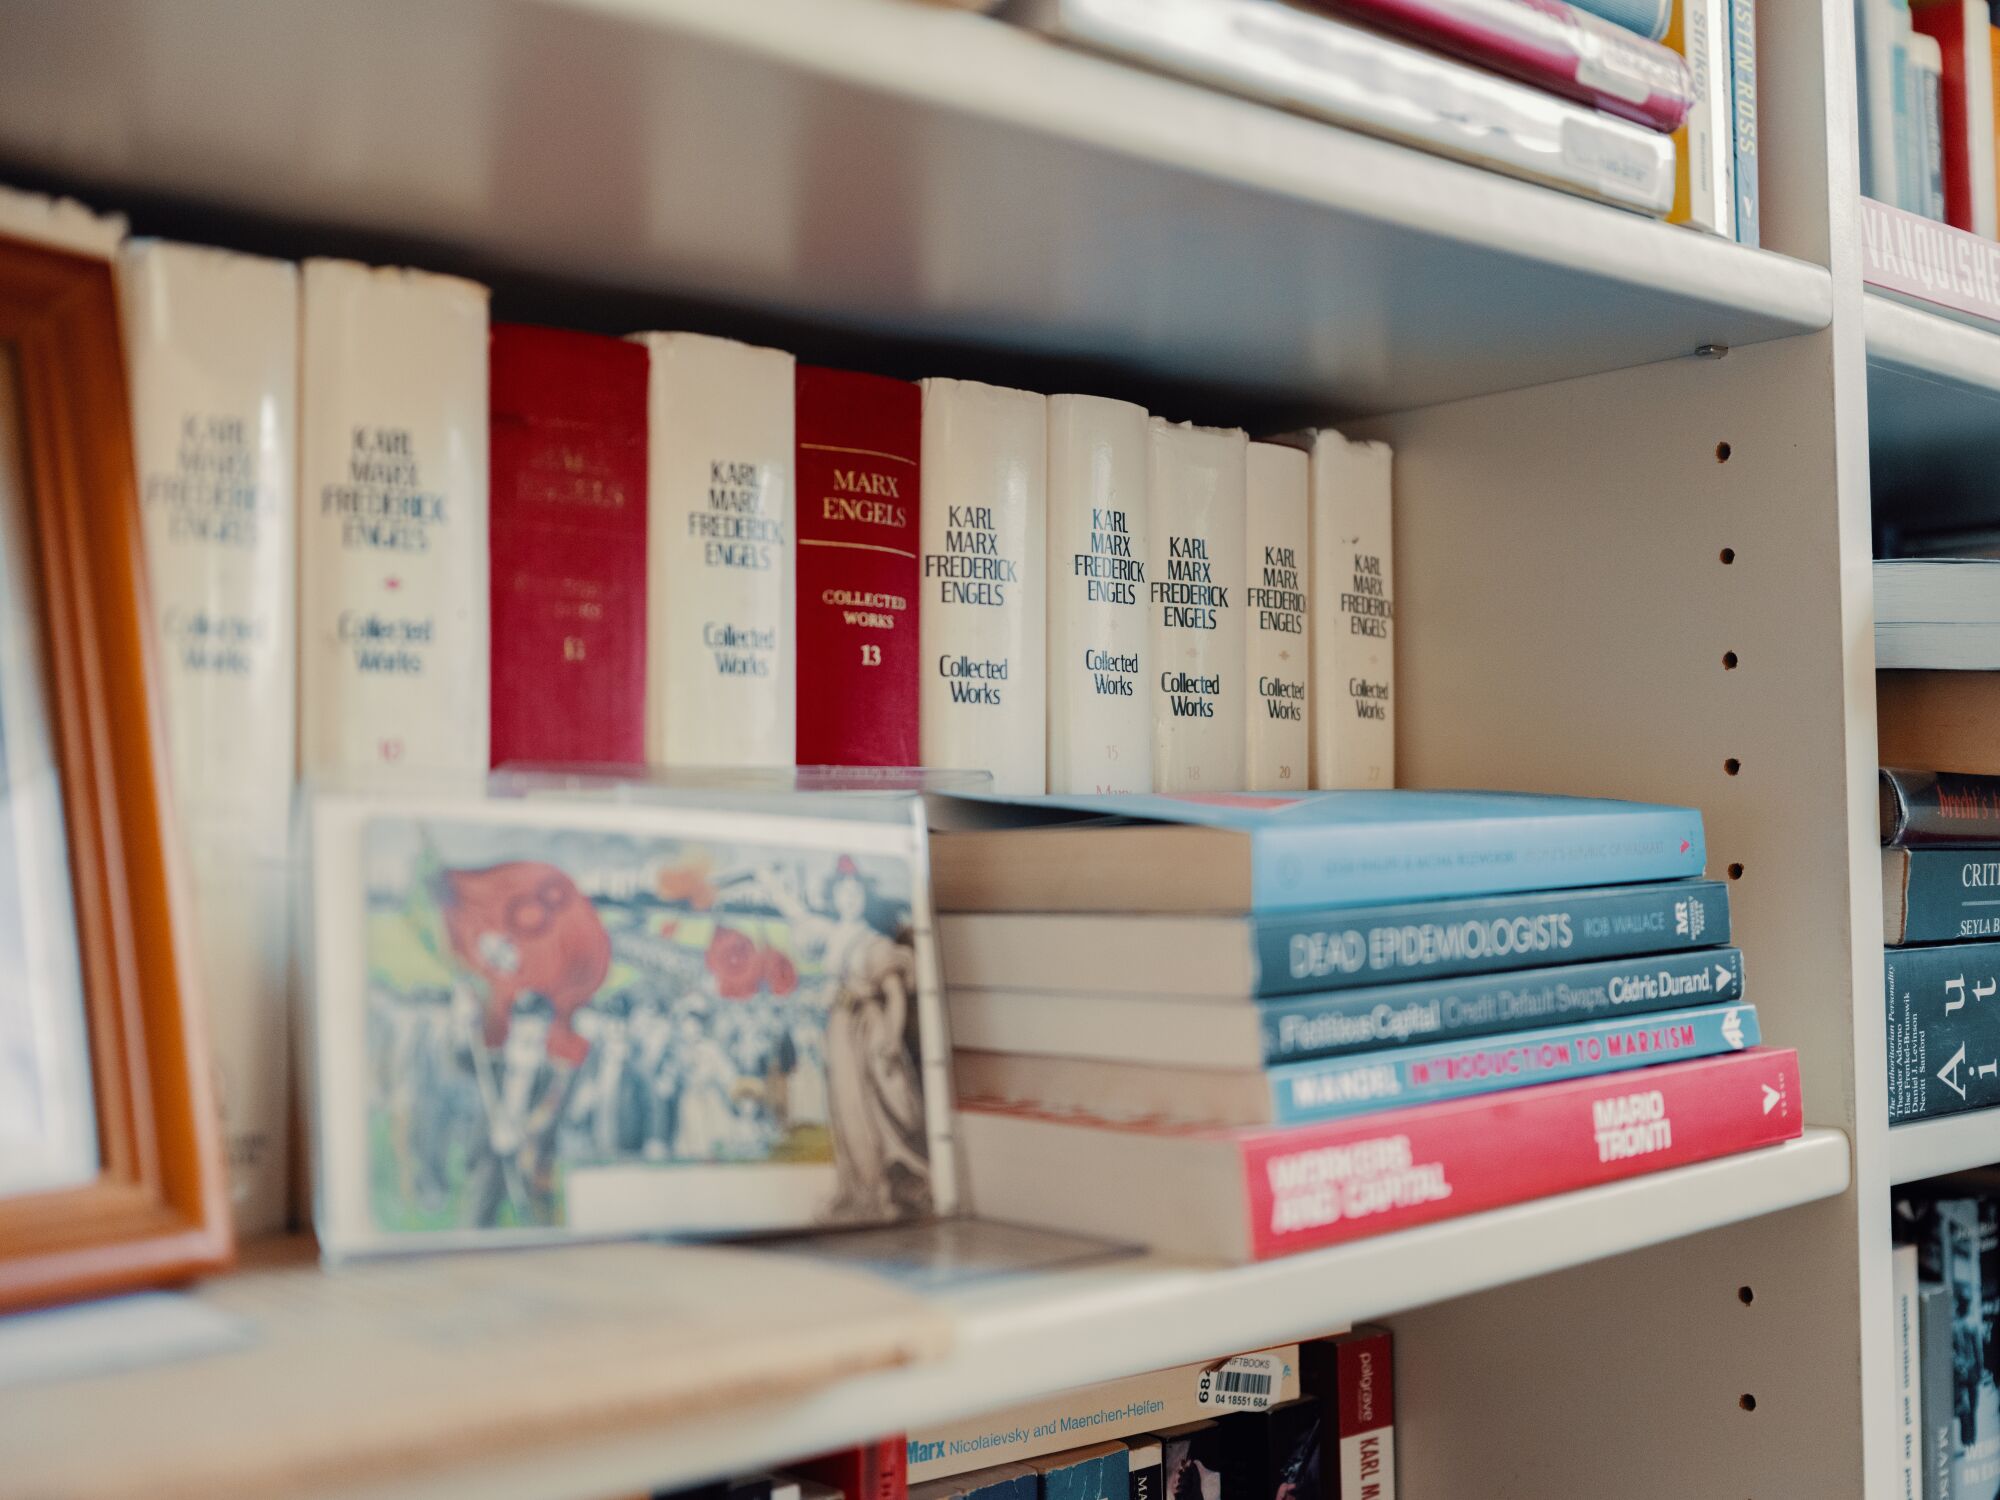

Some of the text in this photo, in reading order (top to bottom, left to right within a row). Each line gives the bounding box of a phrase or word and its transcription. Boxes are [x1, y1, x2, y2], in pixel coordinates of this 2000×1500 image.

[1738, 78, 1755, 155] ROSS
[834, 469, 899, 498] MARX
[823, 498, 906, 528] ENGELS
[949, 505, 995, 531] KARL
[1093, 508, 1128, 533] KARL
[946, 531, 998, 556] MARX
[1091, 532, 1131, 557] MARX
[1169, 536, 1208, 560] KARL
[925, 555, 1017, 583] FREDERICK
[1074, 555, 1145, 583] FREDERICK
[1265, 546, 1296, 569] KARL
[1354, 554, 1381, 577] KARL
[1167, 560, 1211, 583] MARX
[1263, 568, 1298, 590] MARX
[941, 582, 1004, 606] ENGELS
[1088, 580, 1136, 605] ENGELS
[1151, 582, 1229, 608] FREDERICK
[1353, 575, 1383, 597] MARX
[822, 590, 906, 610] COLLECTED
[844, 612, 894, 629] WORKS
[1163, 606, 1217, 630] ENGELS
[1259, 611, 1302, 634] ENGELS
[1351, 616, 1387, 639] ENGELS
[861, 645, 881, 666] 13
[939, 655, 1008, 680] Collected
[1085, 649, 1139, 673] Collected
[950, 682, 1000, 705] Works
[1094, 674, 1133, 696] Works
[1161, 671, 1220, 695] Collected
[1259, 677, 1304, 701] Collected
[1349, 677, 1388, 701] Collected
[1170, 696, 1214, 718] Works
[1267, 699, 1301, 721] Works
[1356, 700, 1385, 720] Works
[1279, 766, 1290, 779] 20
[1584, 912, 1665, 938] ROB WALLACE
[1675, 902, 1689, 935] MR
[1960, 919, 1990, 935] SEYLA
[1289, 913, 1573, 979] DEAD EPIDEMIOLOGISTS
[1609, 974, 1657, 1004] Cédric
[1903, 992, 1911, 1089] Frenkel-Brunswik
[1409, 1042, 1571, 1085] INTRODUCTION
[1575, 1037, 1601, 1063] TO
[1607, 1025, 1695, 1057] MARXISM
[1912, 1066, 1918, 1074] J.
[1592, 1090, 1665, 1138] MARIO
[1595, 1117, 1672, 1163] TRONTI
[1359, 1352, 1373, 1421] palgrave
[1216, 1394, 1268, 1407] 04 18551 684
[907, 1440, 946, 1464] Marx
[949, 1428, 1030, 1456] Nicolaievsky
[1034, 1420, 1056, 1438] and
[1360, 1437, 1380, 1500] KARL M
